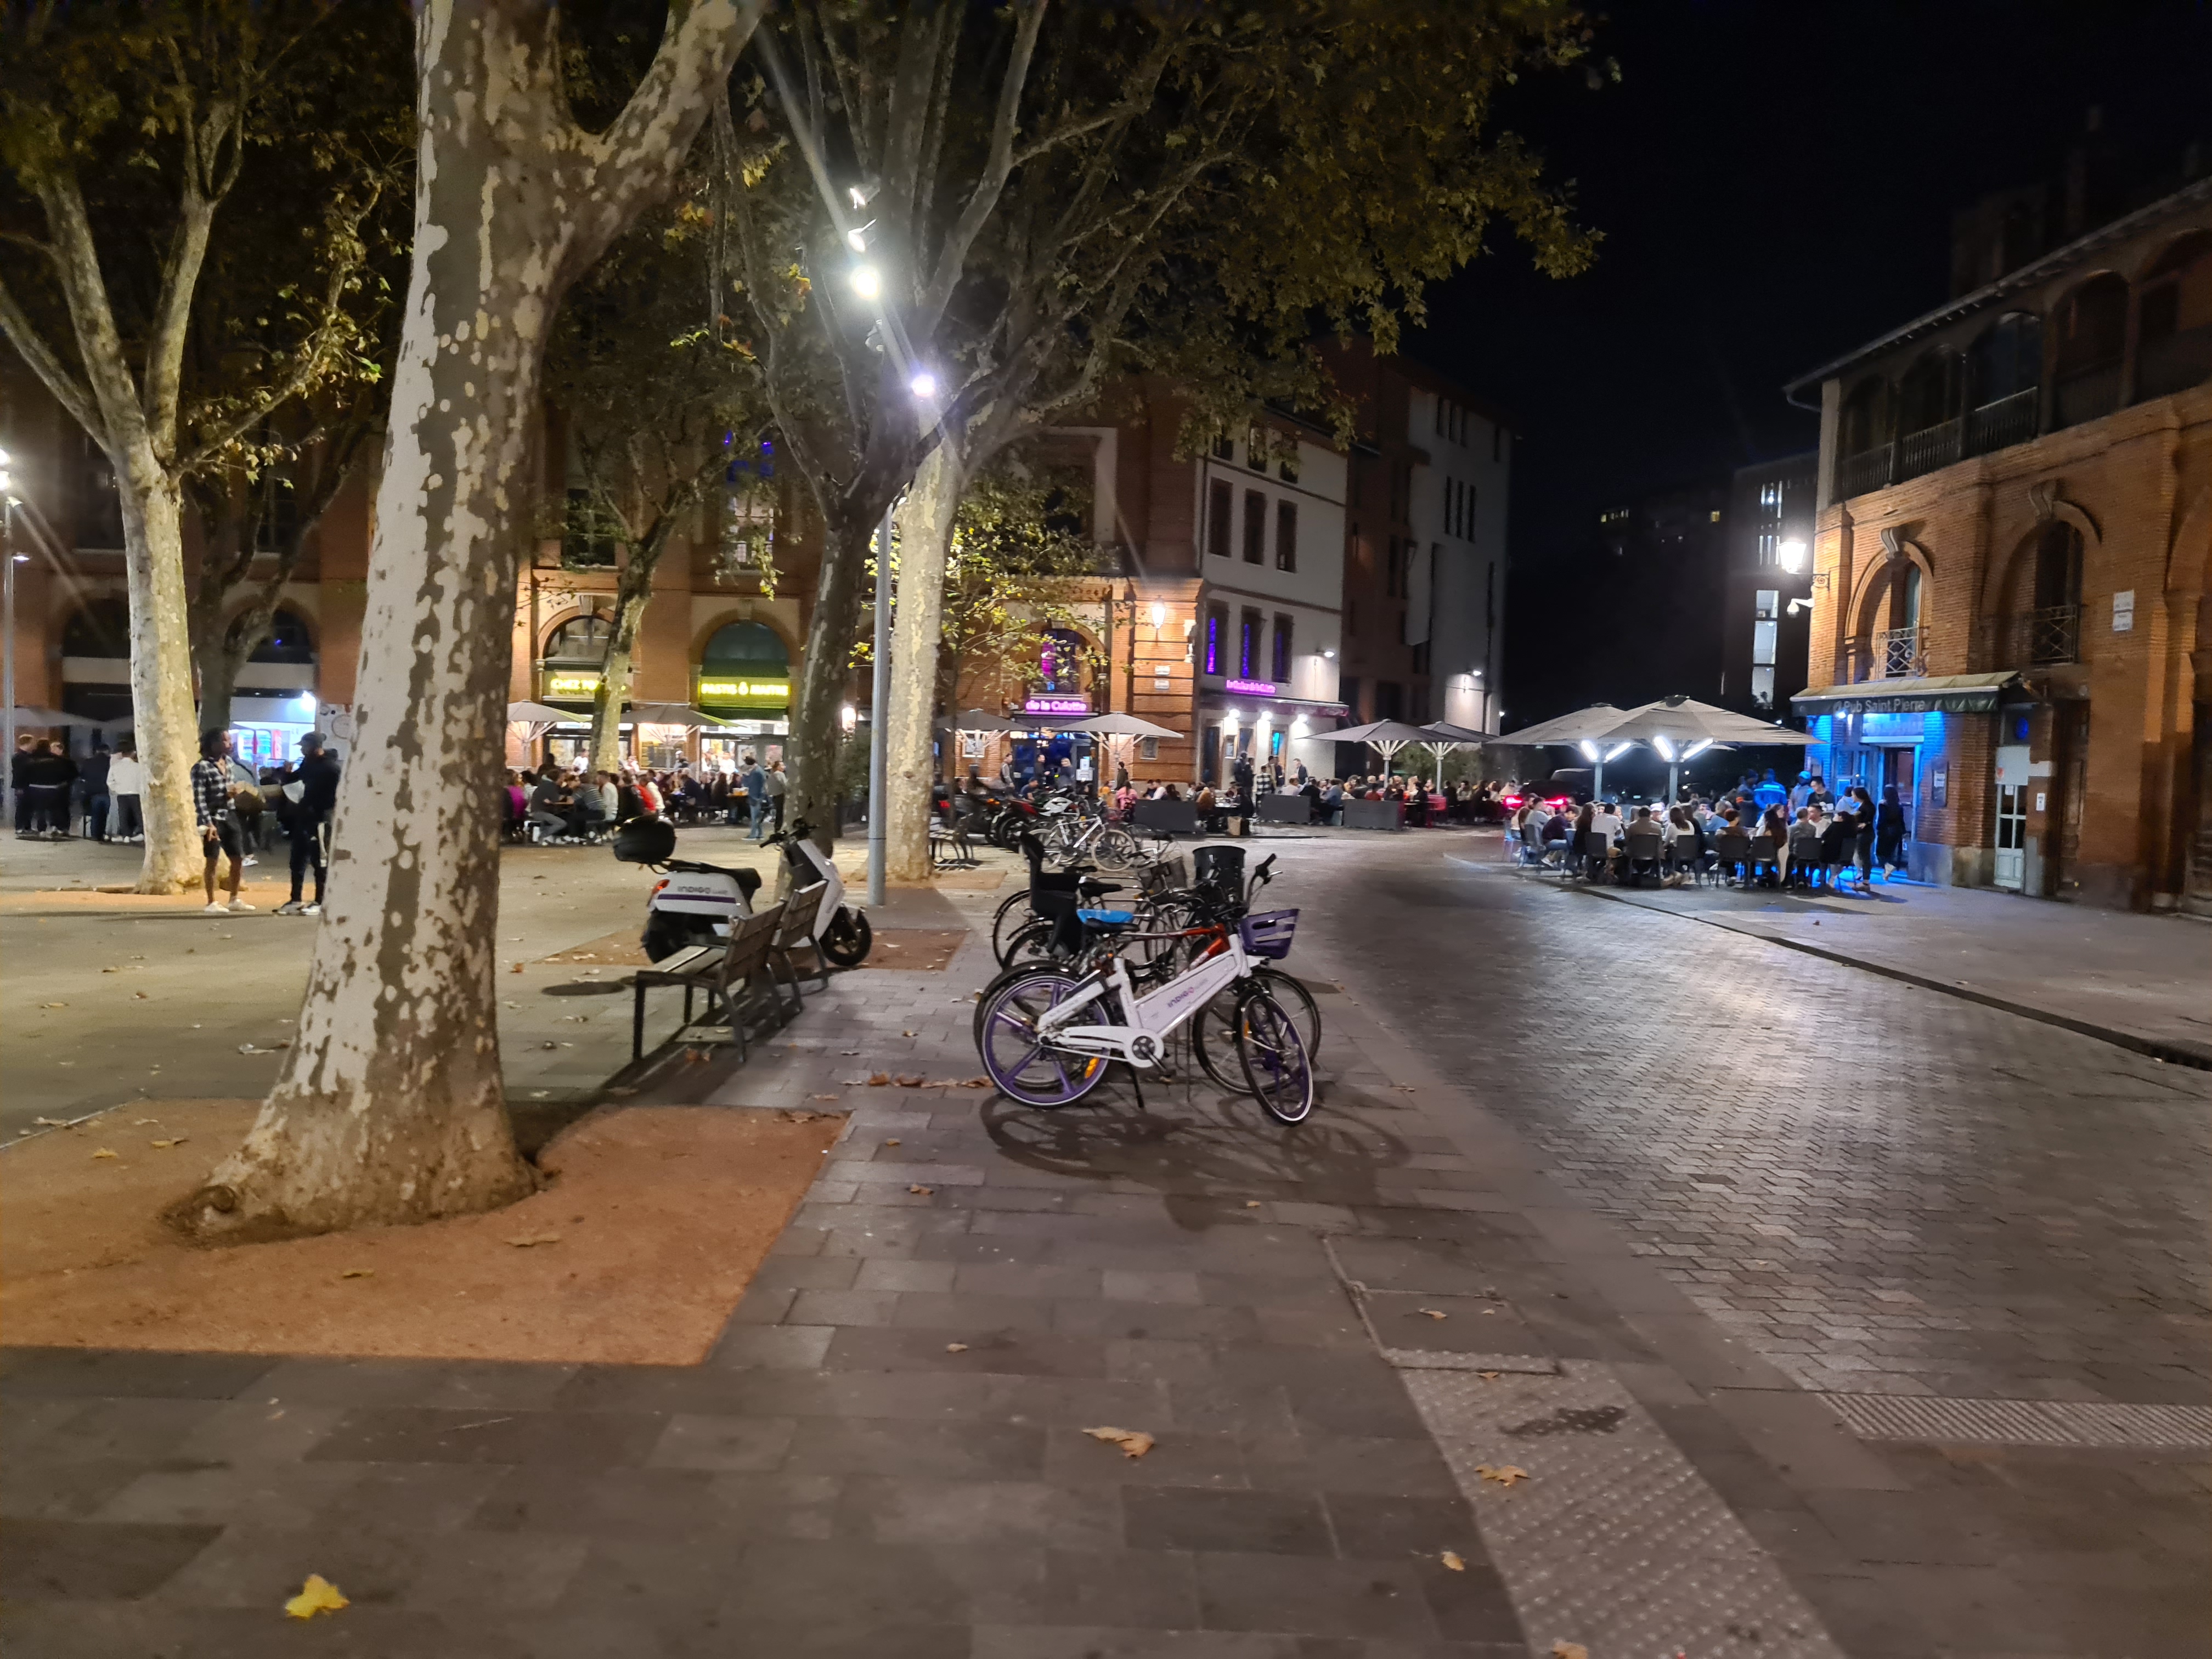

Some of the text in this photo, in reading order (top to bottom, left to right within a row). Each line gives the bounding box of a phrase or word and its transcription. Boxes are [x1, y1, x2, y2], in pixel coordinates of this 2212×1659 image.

[1025, 700, 1087, 712] de la Culotte
[1844, 700, 1863, 713] Pub
[1865, 699, 1891, 712] Saint
[1894, 698, 1925, 712] Pierre
